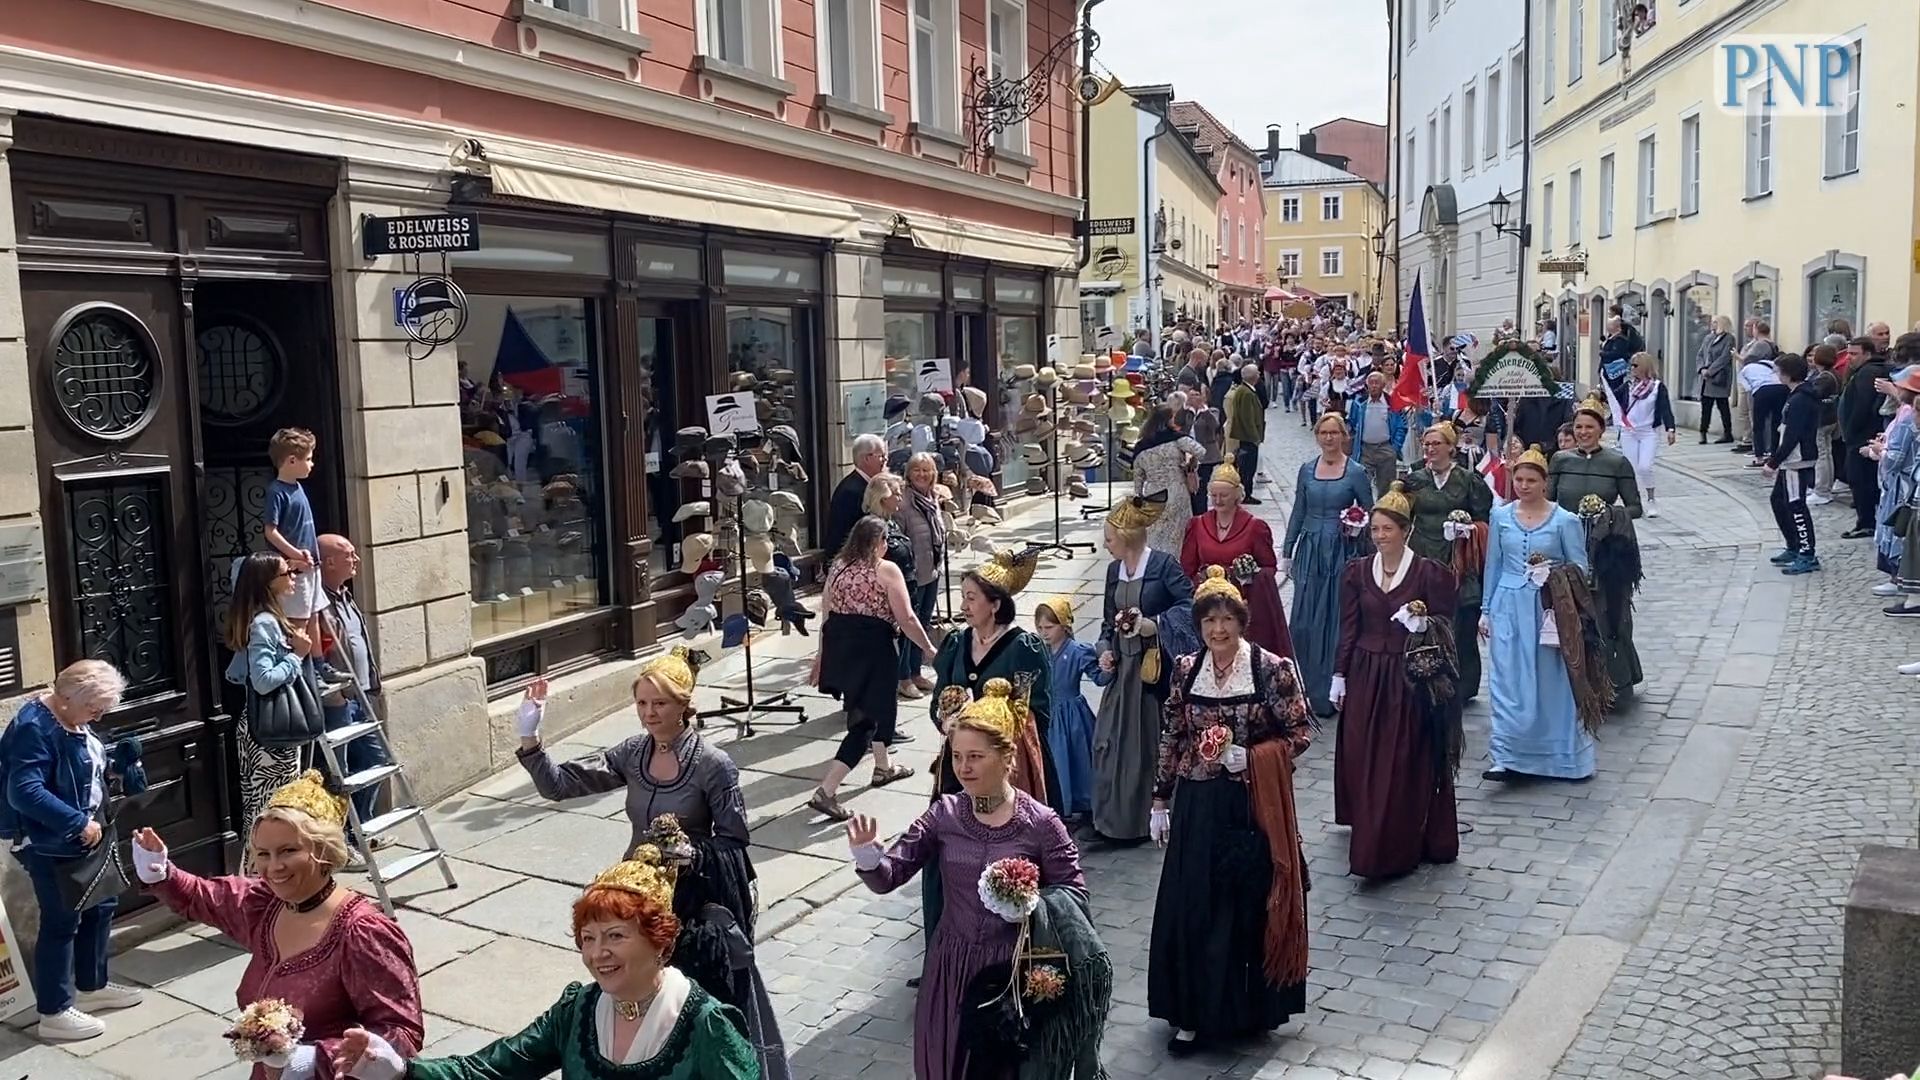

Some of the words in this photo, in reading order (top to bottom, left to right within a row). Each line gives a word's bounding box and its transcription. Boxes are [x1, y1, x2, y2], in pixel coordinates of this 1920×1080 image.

[387, 218, 470, 234] EDELWEISS
[388, 236, 397, 249] &
[398, 233, 470, 249] ROSENROT
